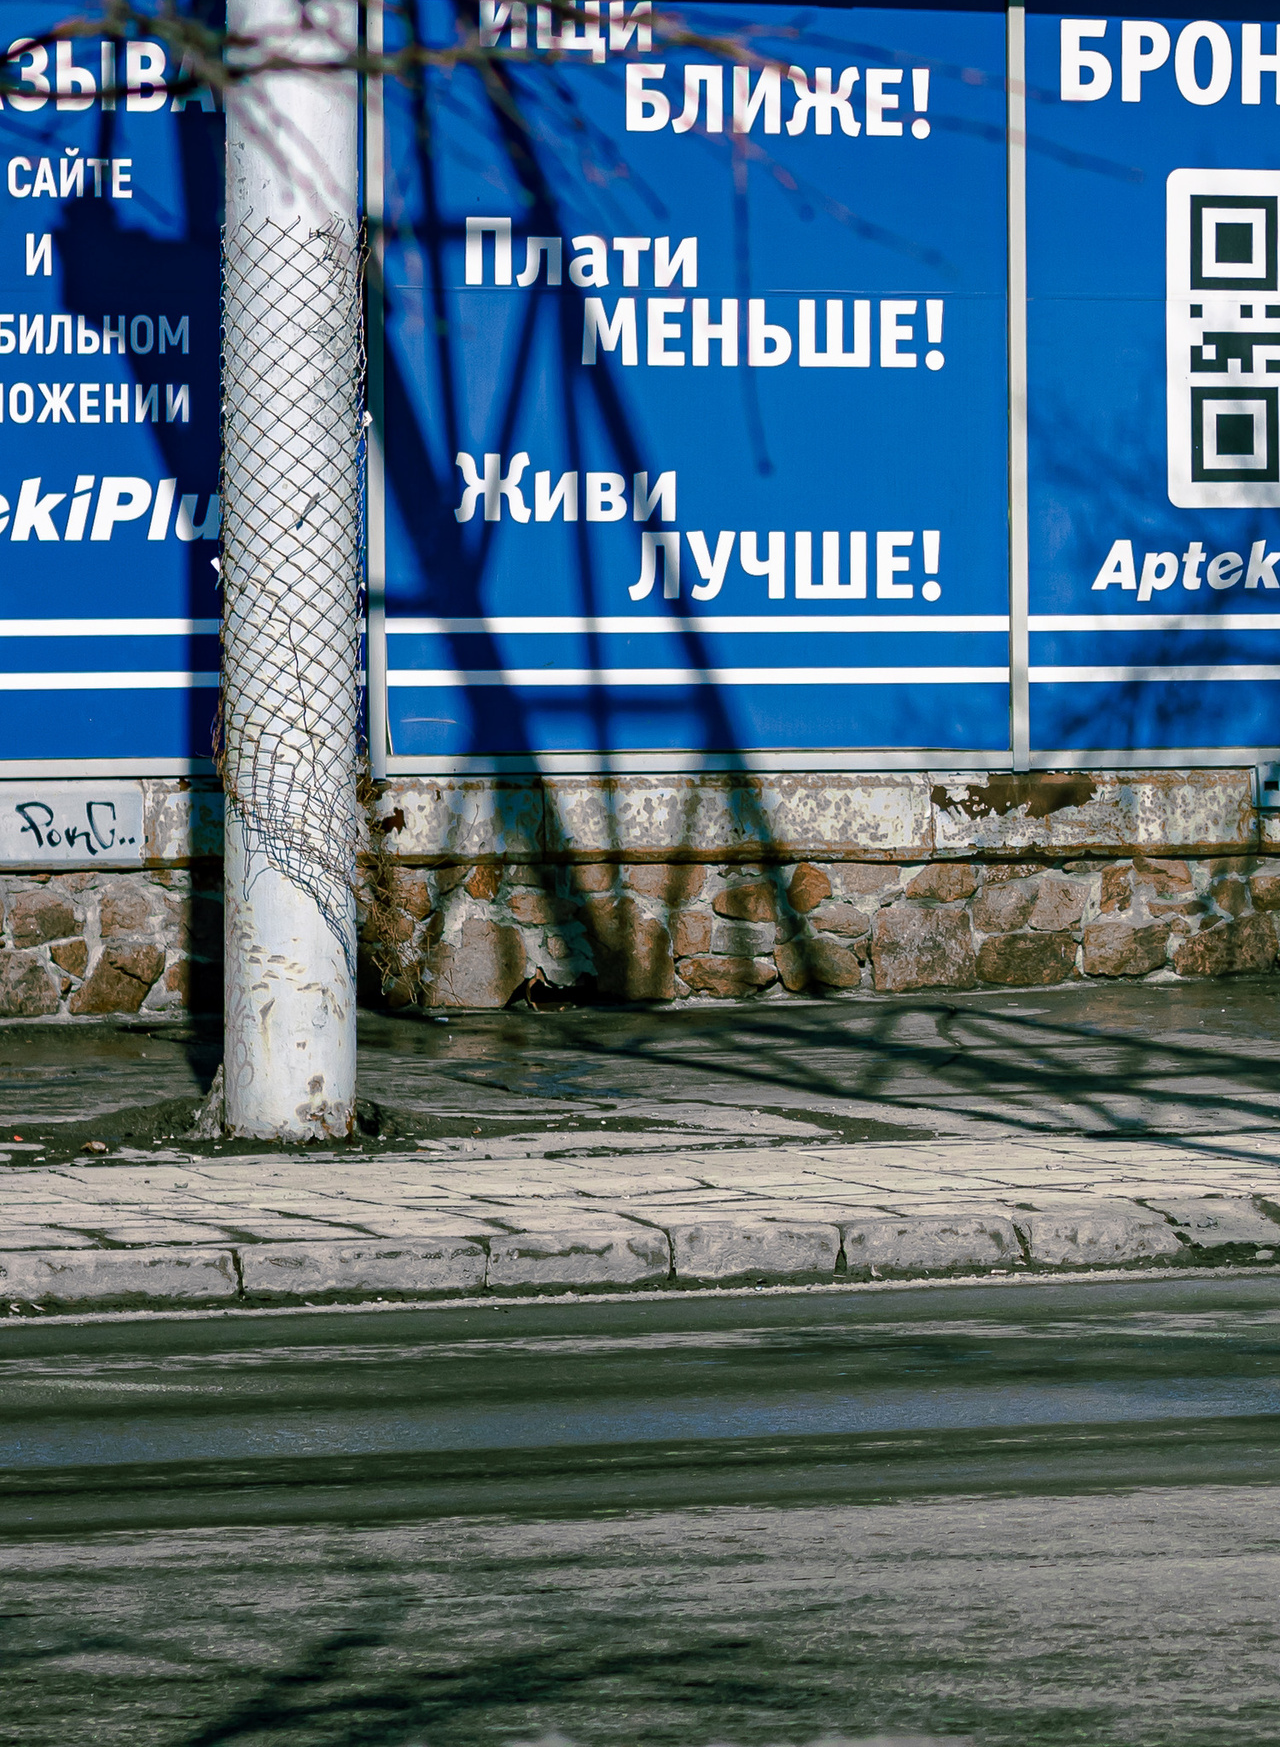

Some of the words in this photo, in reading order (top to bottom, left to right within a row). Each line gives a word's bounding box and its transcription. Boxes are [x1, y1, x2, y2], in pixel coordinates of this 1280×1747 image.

[625, 64, 930, 139] БЛИЖЕ!
[7, 148, 133, 199] САЙТЕ
[26, 234, 52, 276] И
[465, 217, 698, 287] Плати
[581, 297, 945, 371] МЕНЬШЕ!
[0, 382, 190, 424] ОЖЕНИИ
[454, 452, 677, 523] Живи
[628, 530, 942, 602] ЛУЧШЕ!
